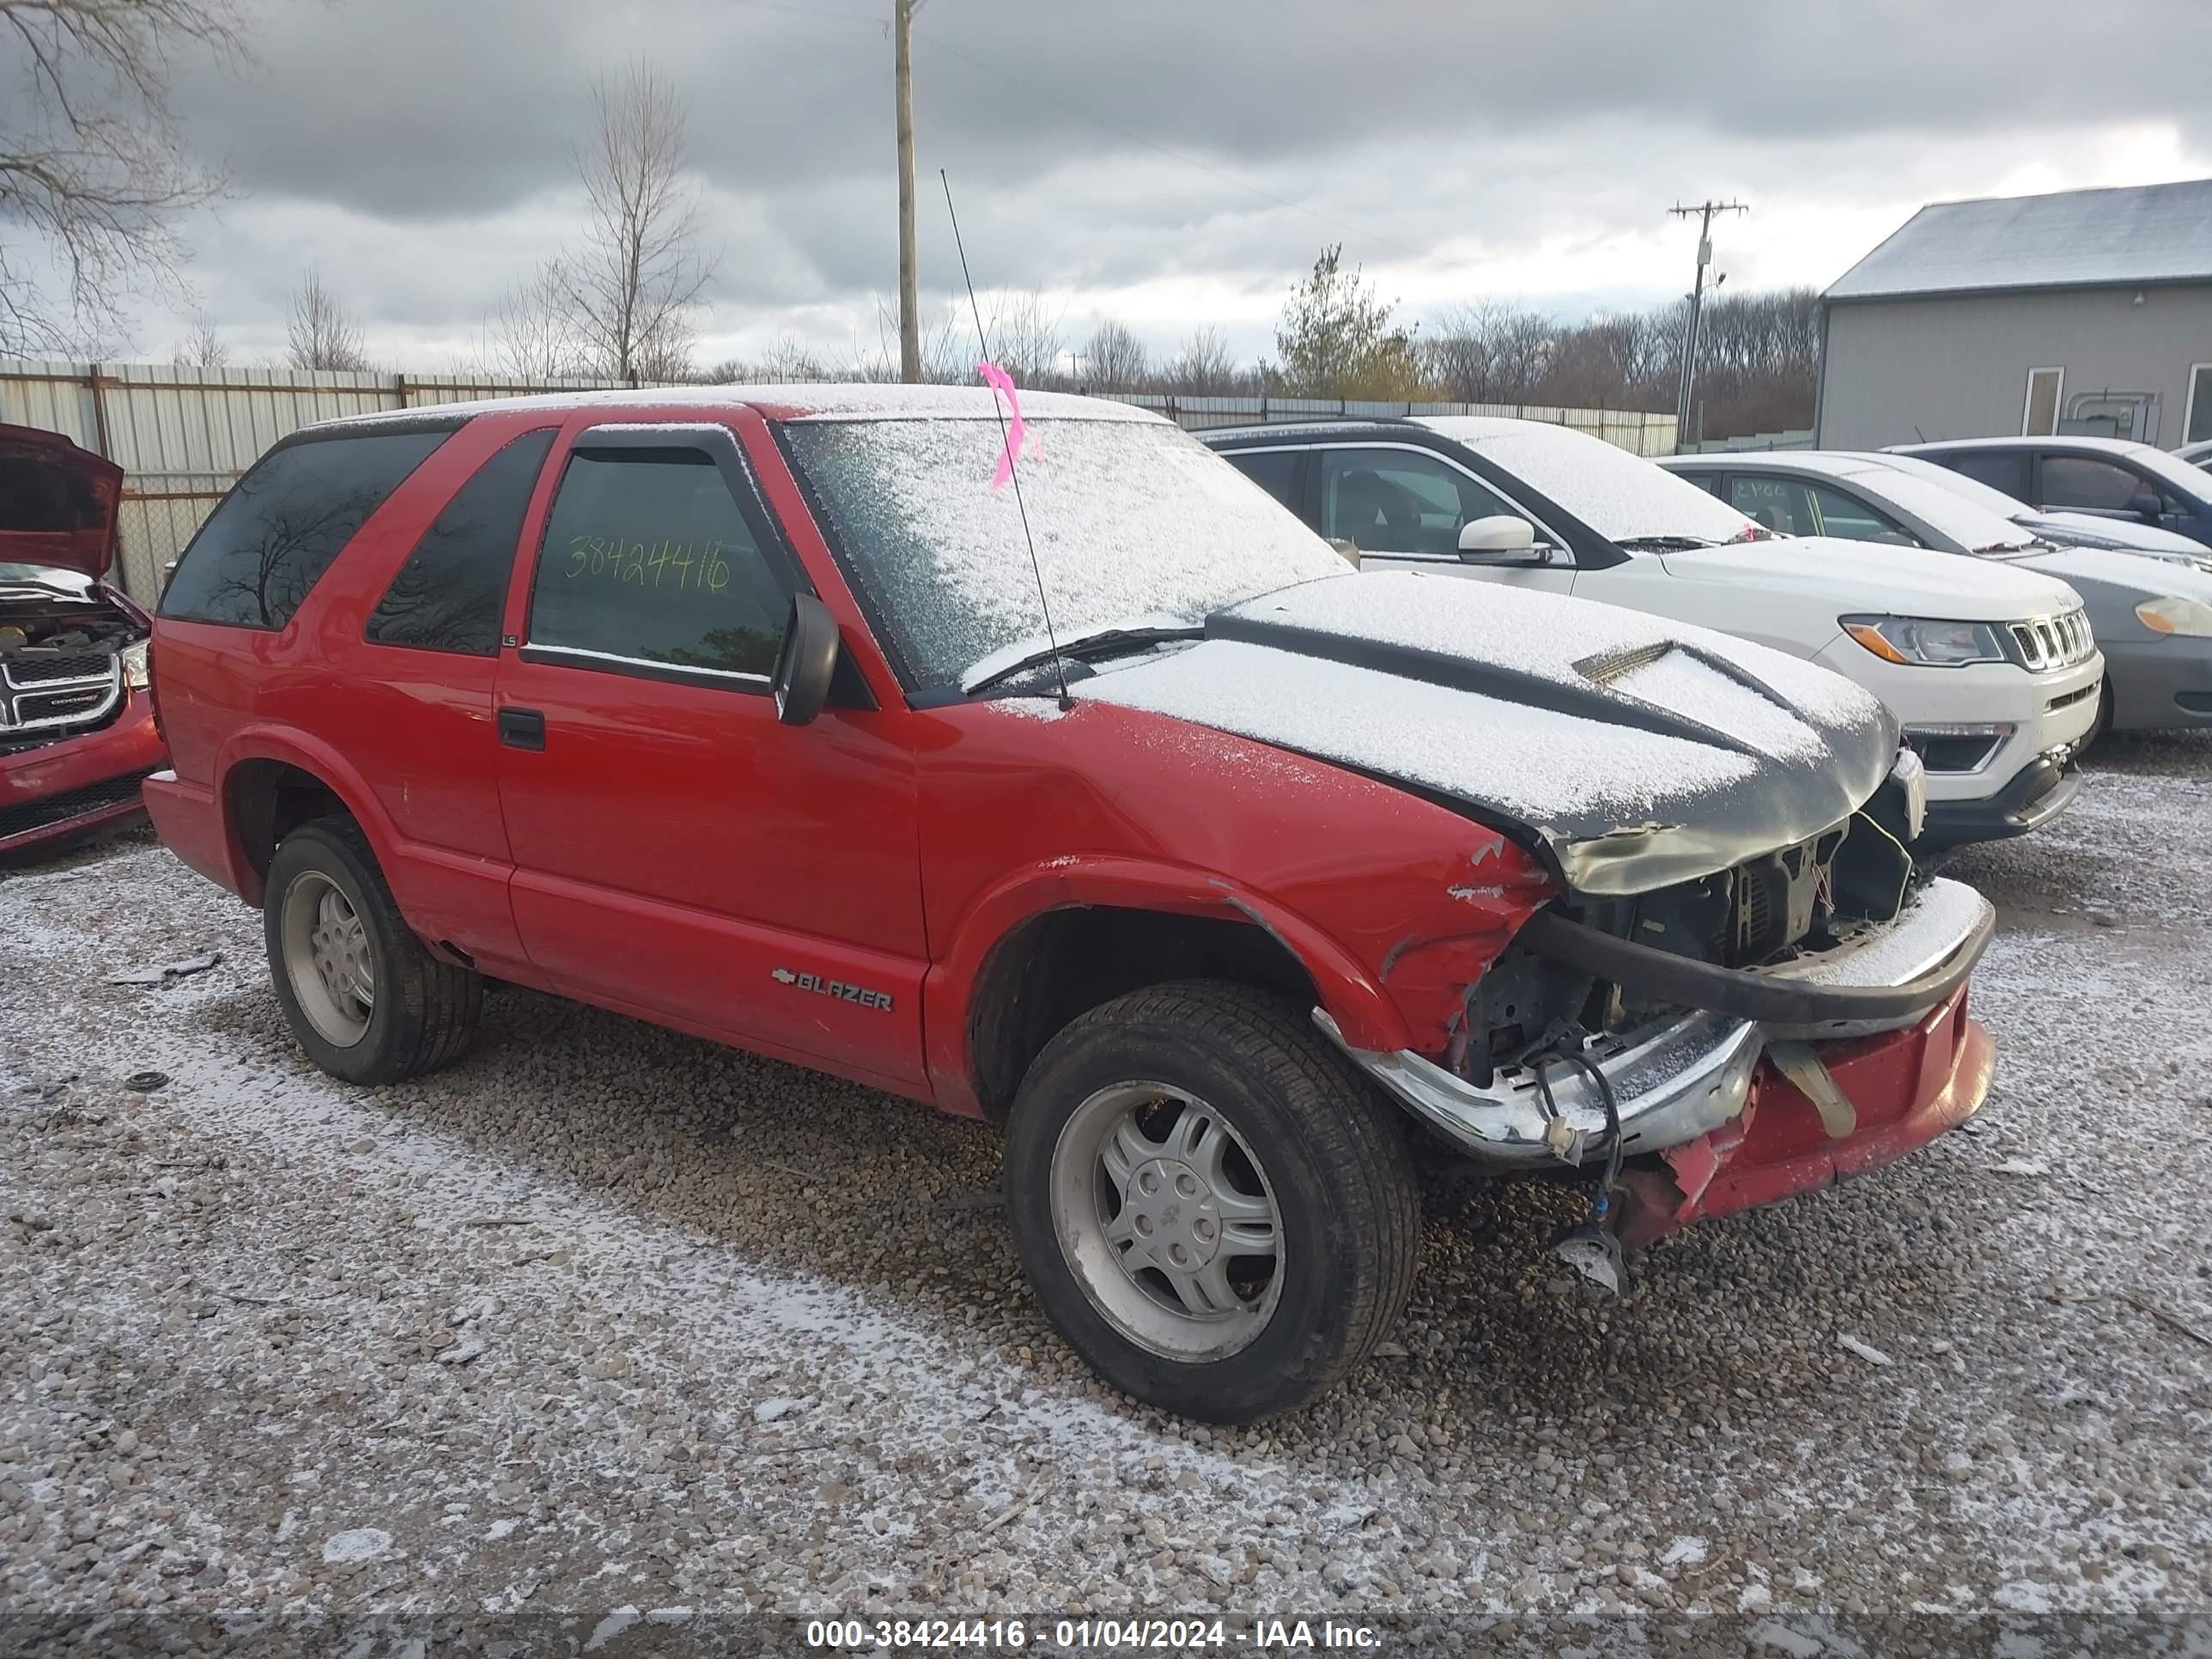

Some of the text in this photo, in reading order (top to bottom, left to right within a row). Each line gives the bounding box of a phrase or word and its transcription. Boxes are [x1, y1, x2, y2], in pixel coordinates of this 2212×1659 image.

[563, 535, 730, 594] 38424416
[502, 635, 516, 646] LS
[797, 971, 892, 1012] BLAZER
